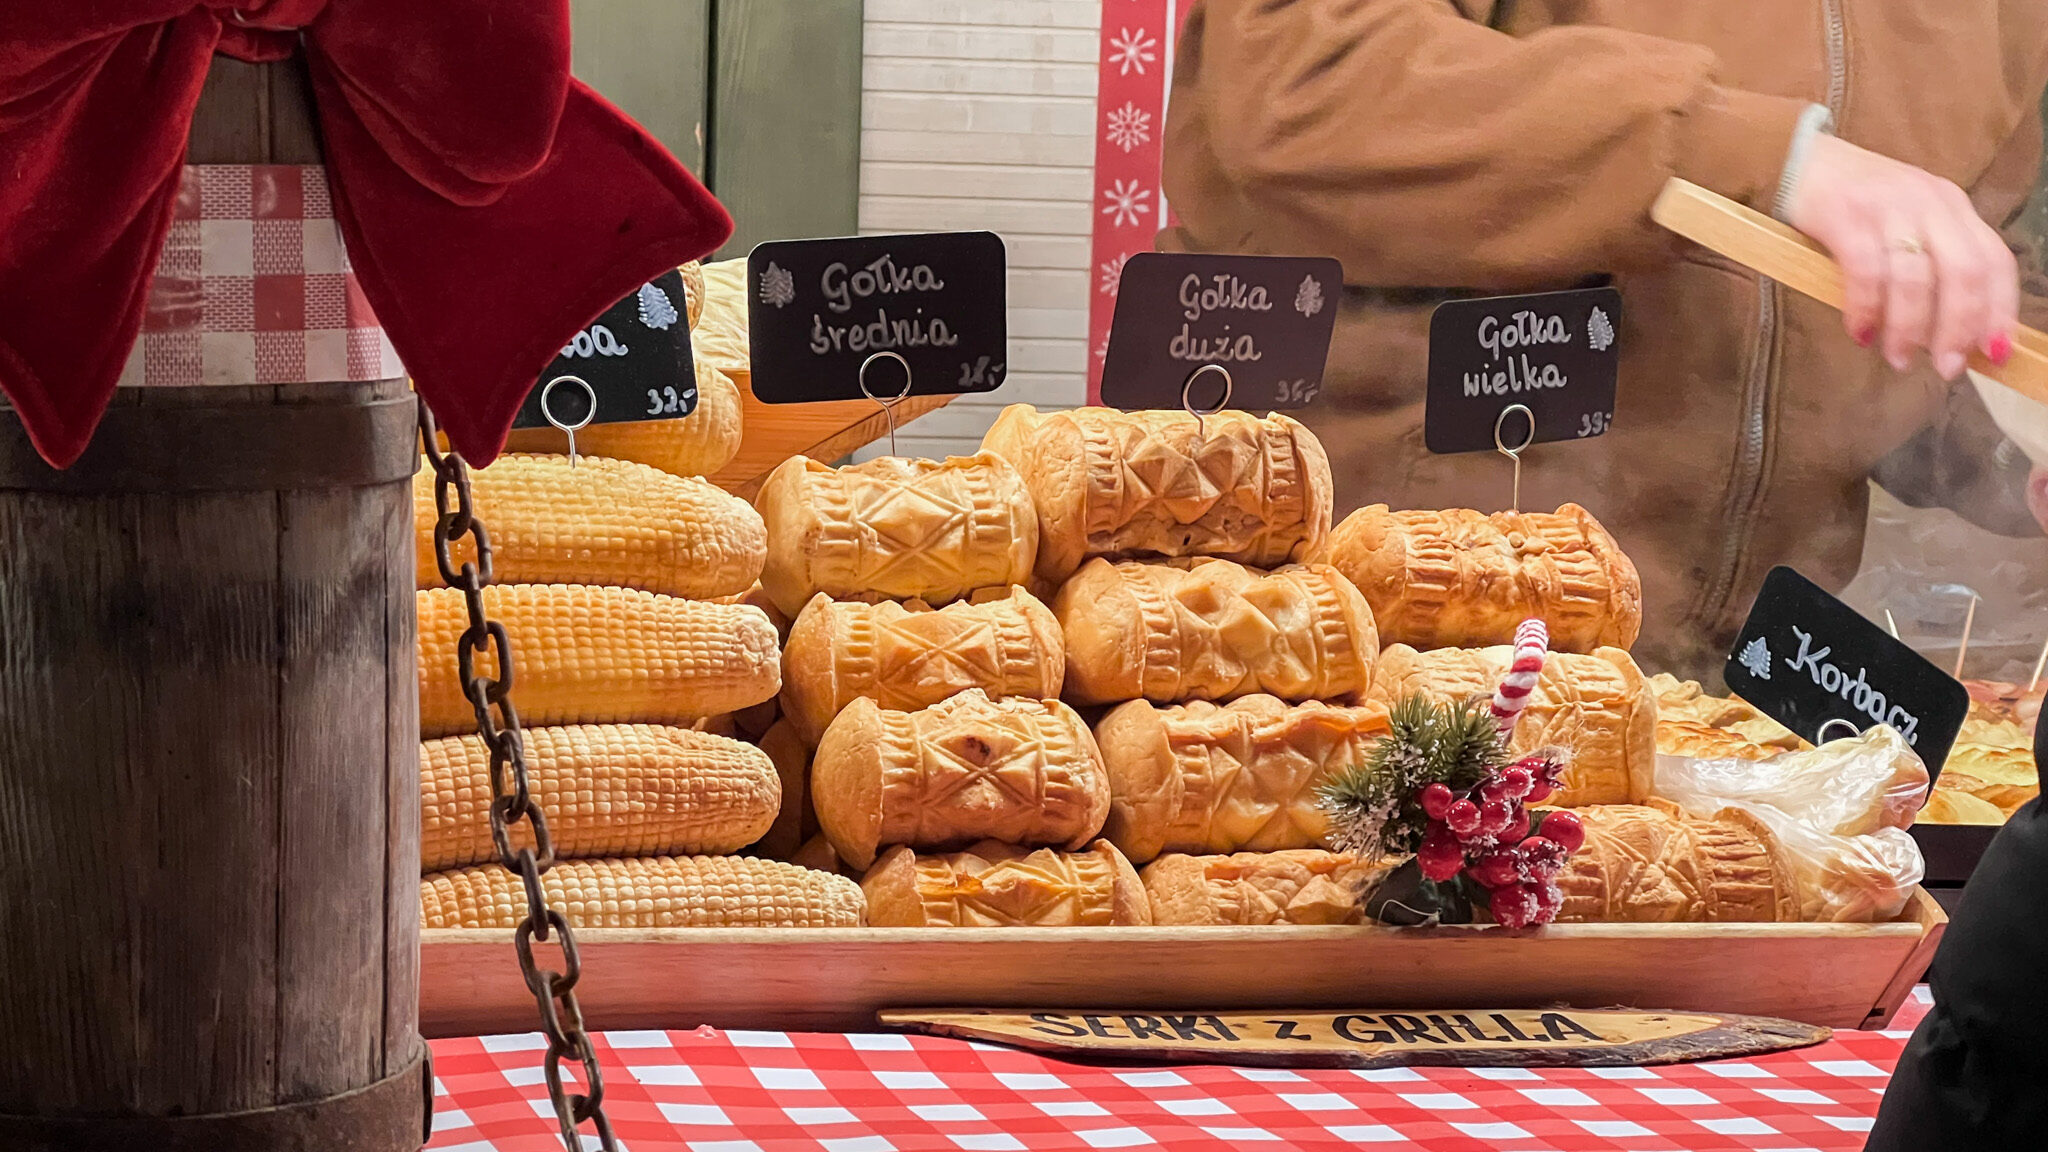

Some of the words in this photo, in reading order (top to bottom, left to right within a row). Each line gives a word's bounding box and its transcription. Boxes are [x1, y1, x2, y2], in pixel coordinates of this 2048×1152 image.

[1169, 323, 1262, 361] duża
[1463, 353, 1567, 397] wielka
[1785, 625, 1918, 746] Korbacz
[1030, 1012, 1240, 1041] SERKI
[1332, 1012, 1605, 1044] GRILLA
